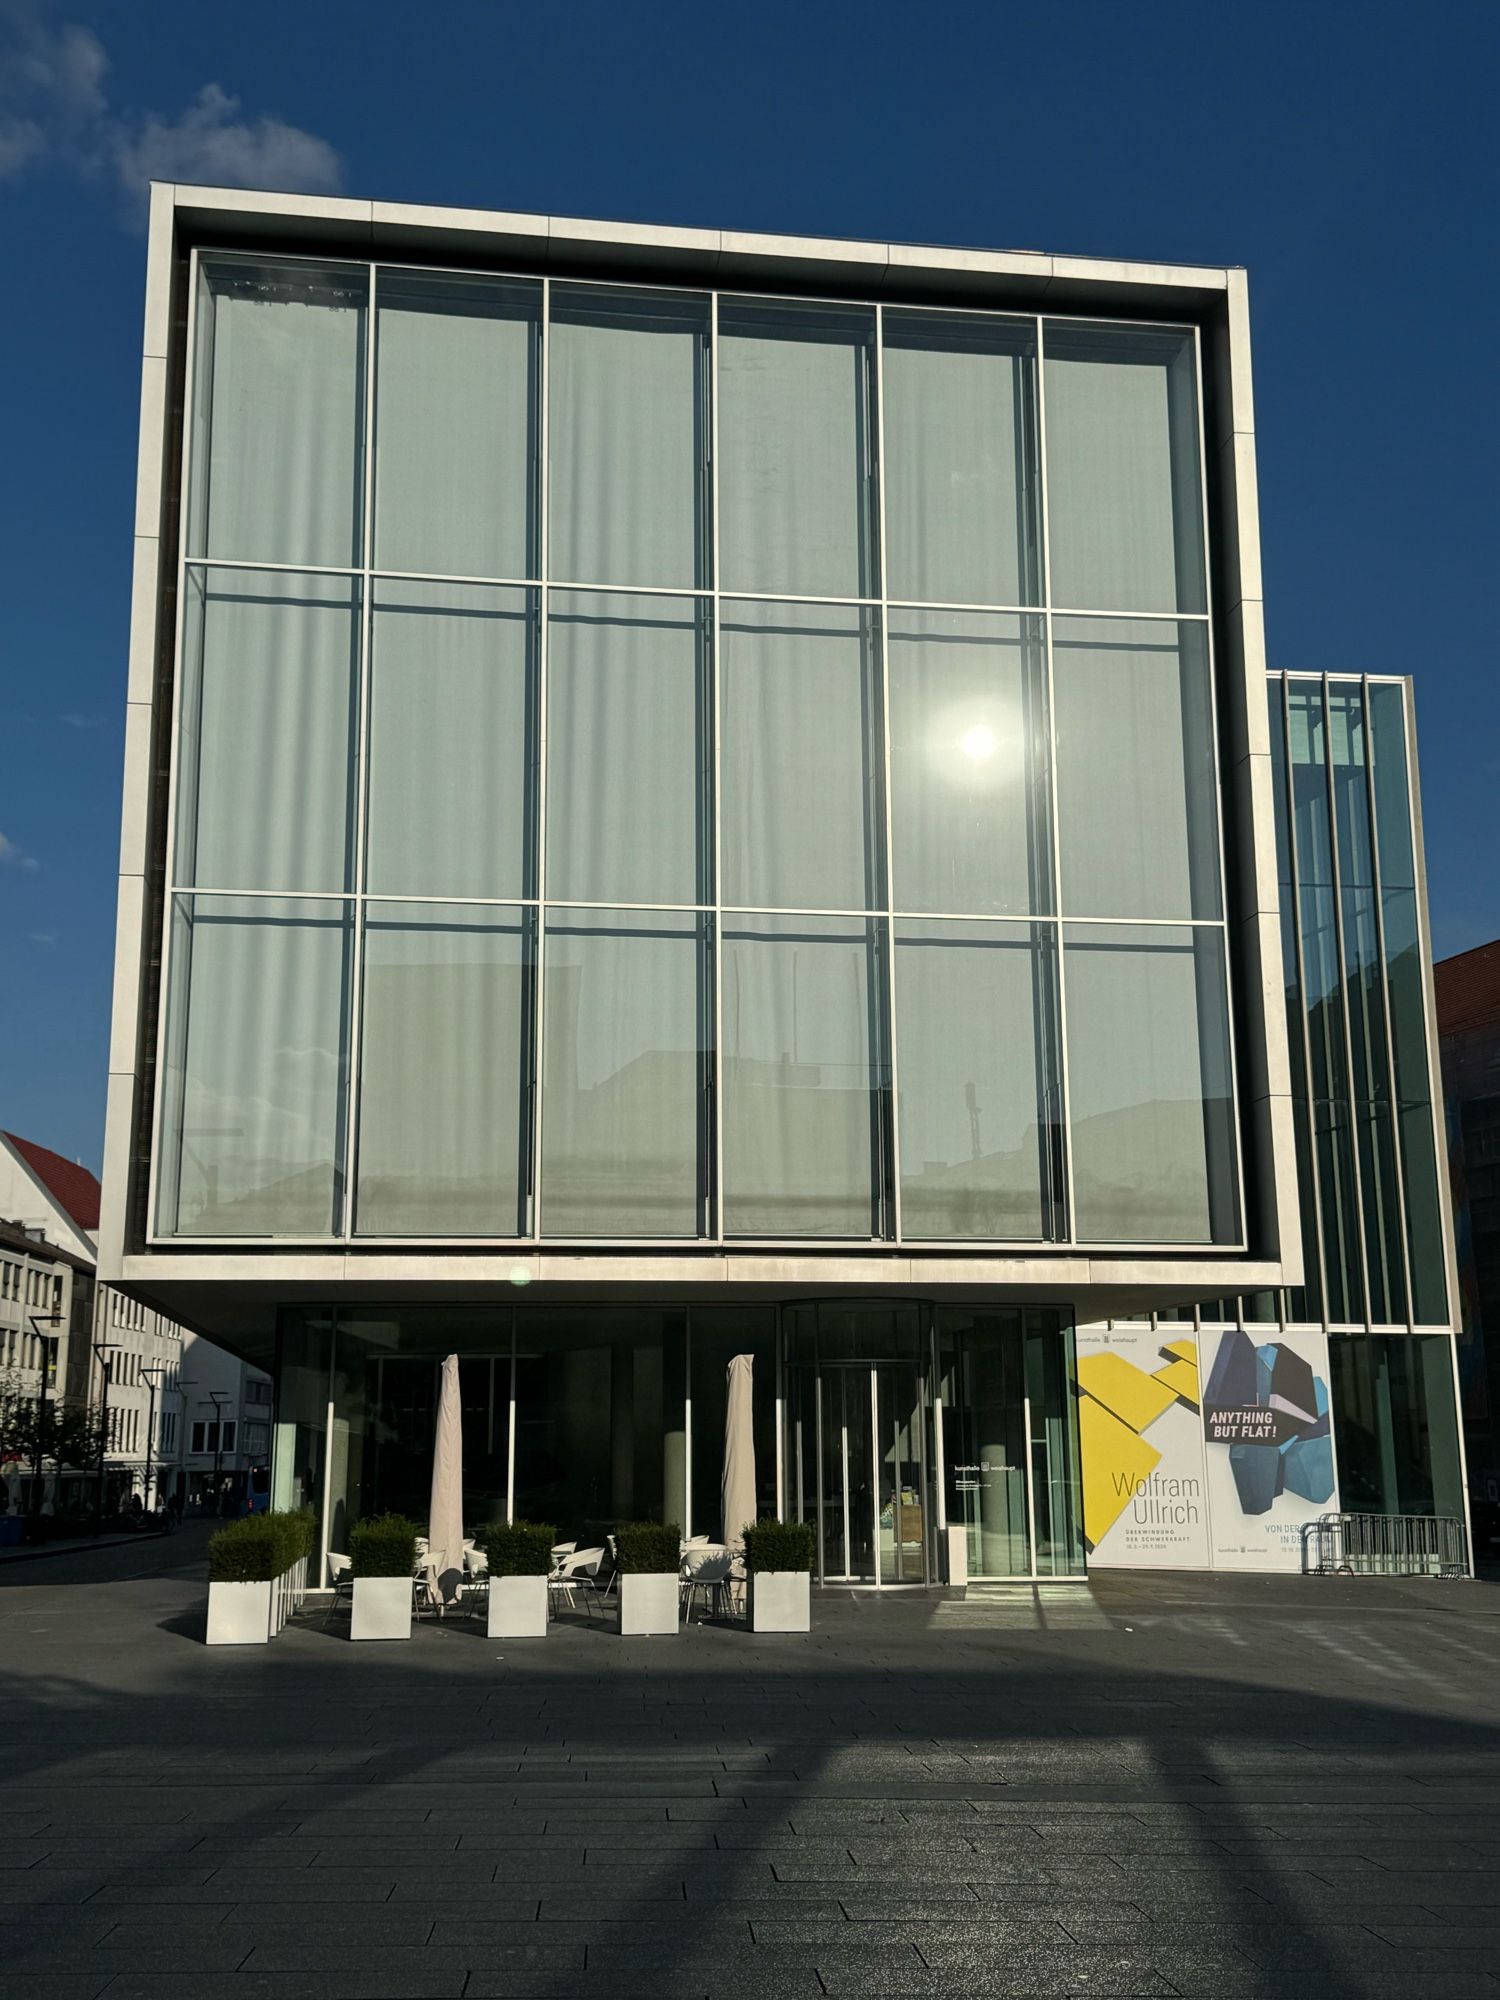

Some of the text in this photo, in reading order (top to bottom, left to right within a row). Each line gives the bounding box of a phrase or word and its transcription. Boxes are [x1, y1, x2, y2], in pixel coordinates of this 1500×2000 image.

[1209, 1411, 1273, 1424] ANYTHING
[1214, 1426, 1277, 1438] BUT FLAT!
[1111, 1472, 1200, 1497] Wolfram
[1133, 1499, 1199, 1525] Ullrich
[1264, 1524, 1282, 1533] VON
[1284, 1524, 1301, 1533] DER
[1280, 1535, 1290, 1544] IN
[1291, 1535, 1307, 1544] DE
